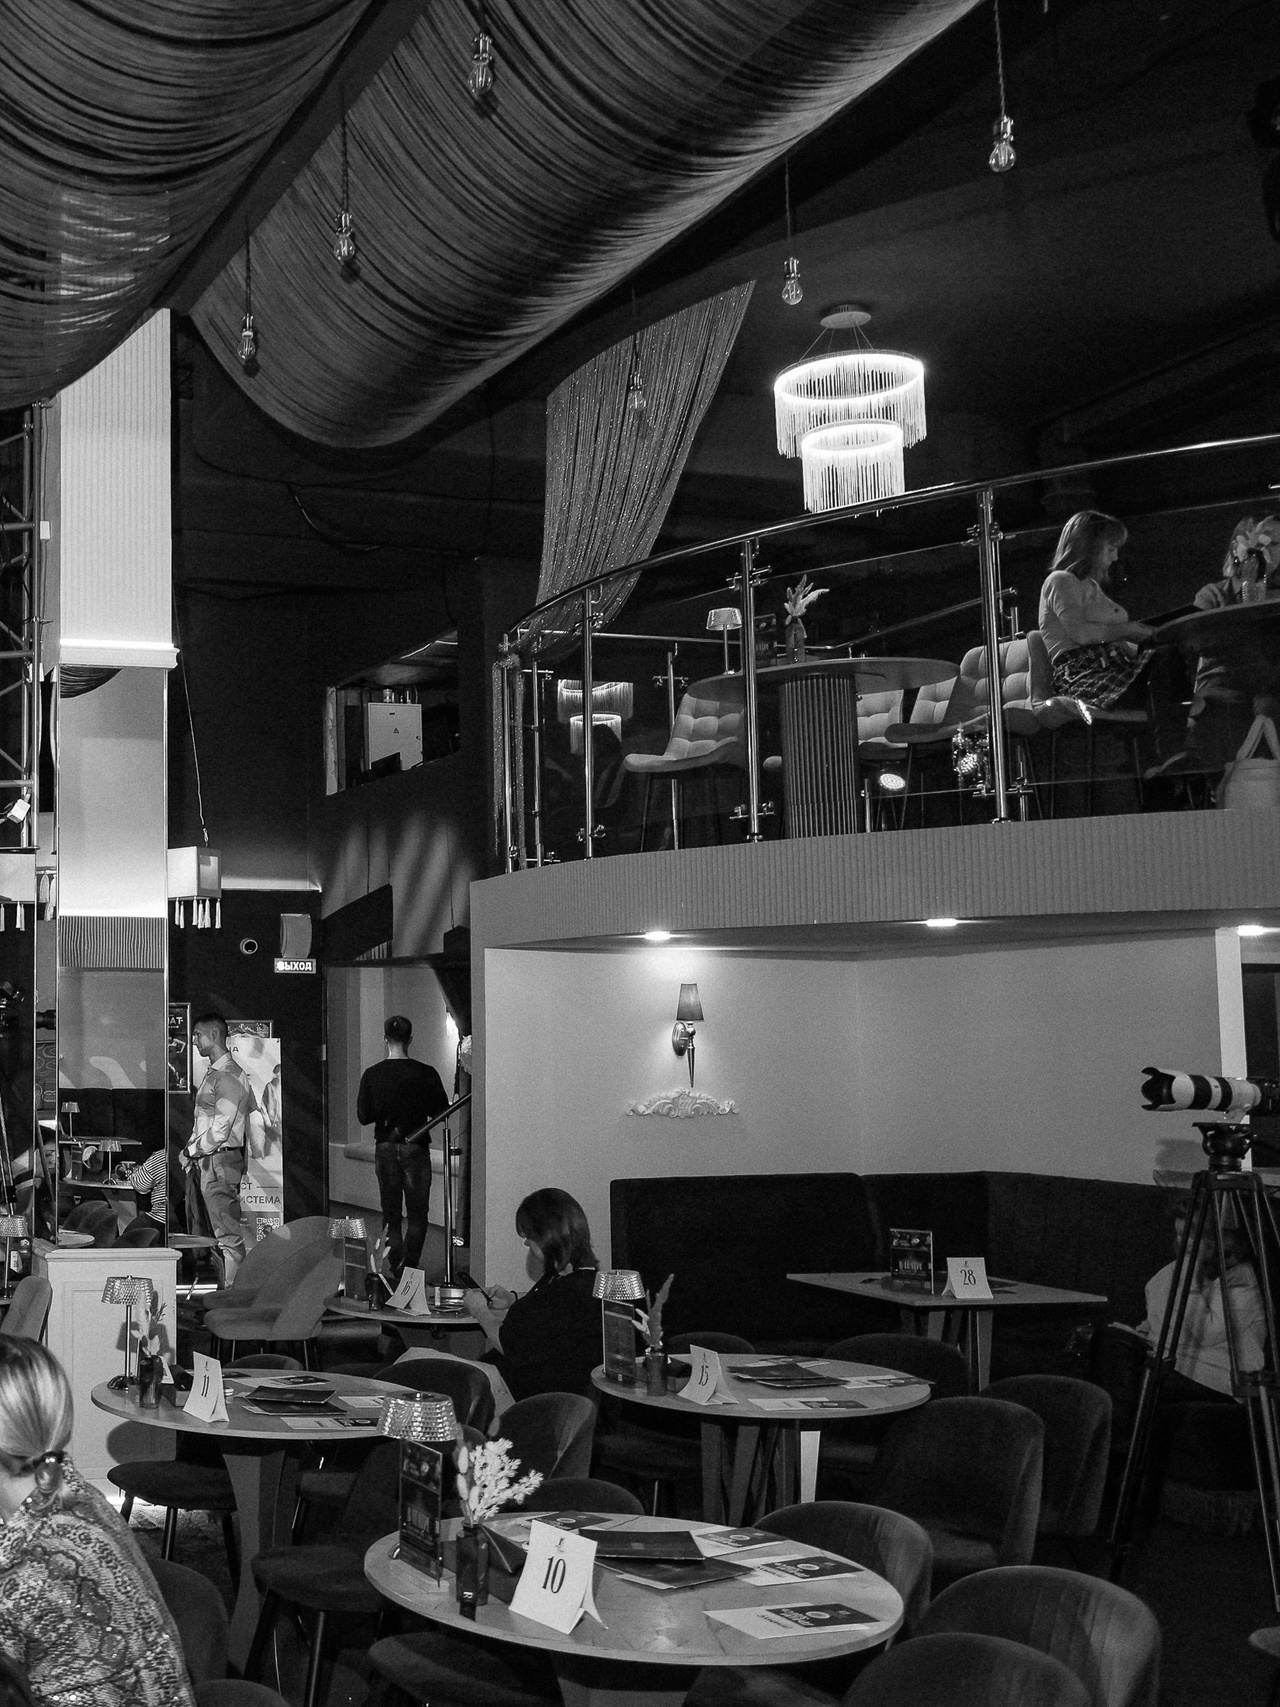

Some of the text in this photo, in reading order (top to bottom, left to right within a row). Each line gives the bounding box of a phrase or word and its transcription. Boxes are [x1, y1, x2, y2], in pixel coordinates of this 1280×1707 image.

[401, 1280, 413, 1296] 16
[960, 1269, 977, 1286] 28
[201, 1374, 210, 1398] 11
[698, 1365, 709, 1387] 15
[541, 1555, 567, 1594] 10
